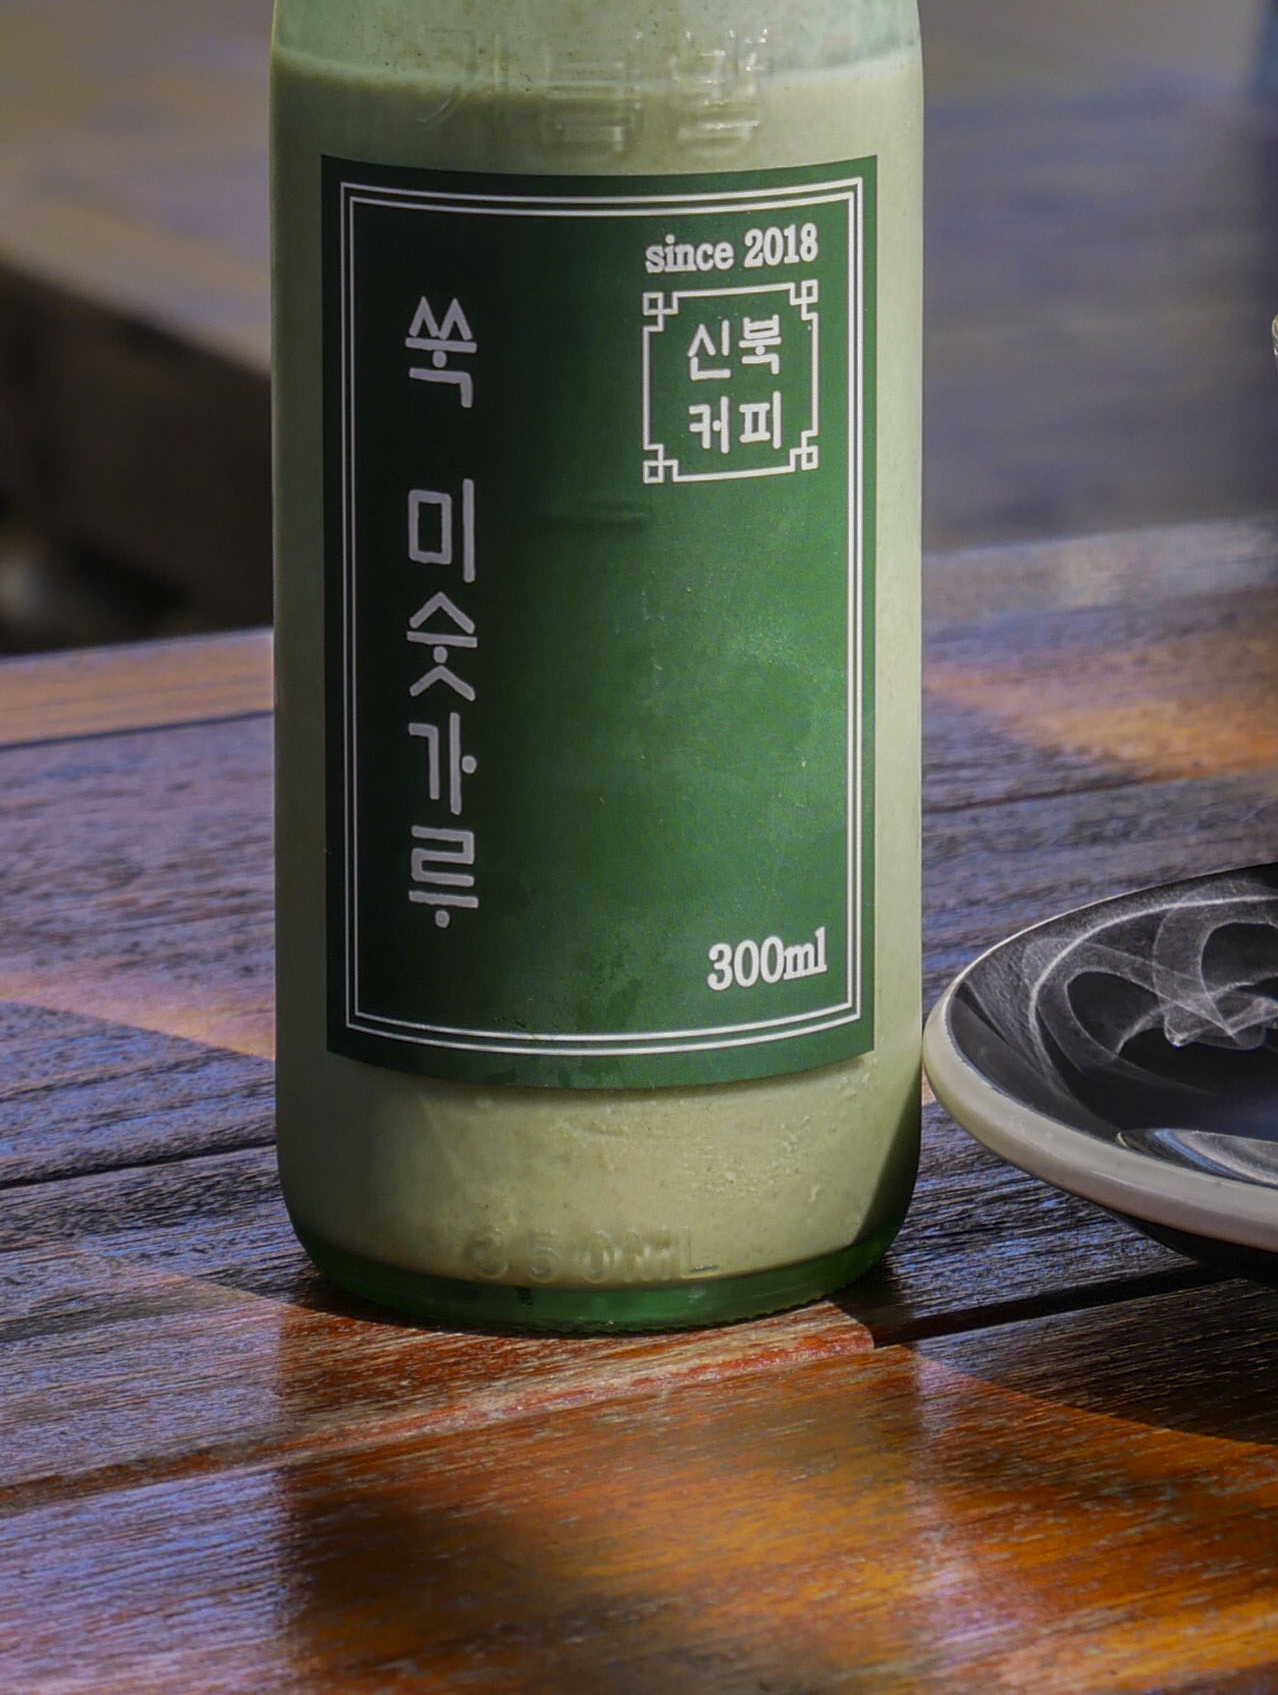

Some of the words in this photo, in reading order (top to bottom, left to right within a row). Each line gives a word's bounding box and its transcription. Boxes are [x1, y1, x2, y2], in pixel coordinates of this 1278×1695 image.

[645, 234, 734, 273] since
[743, 223, 818, 268] 2018
[405, 295, 477, 408] 쑥
[687, 314, 782, 381] 신북
[688, 390, 781, 454] 커피
[406, 478, 479, 929] 미숫가루
[707, 925, 828, 991] 300ml
